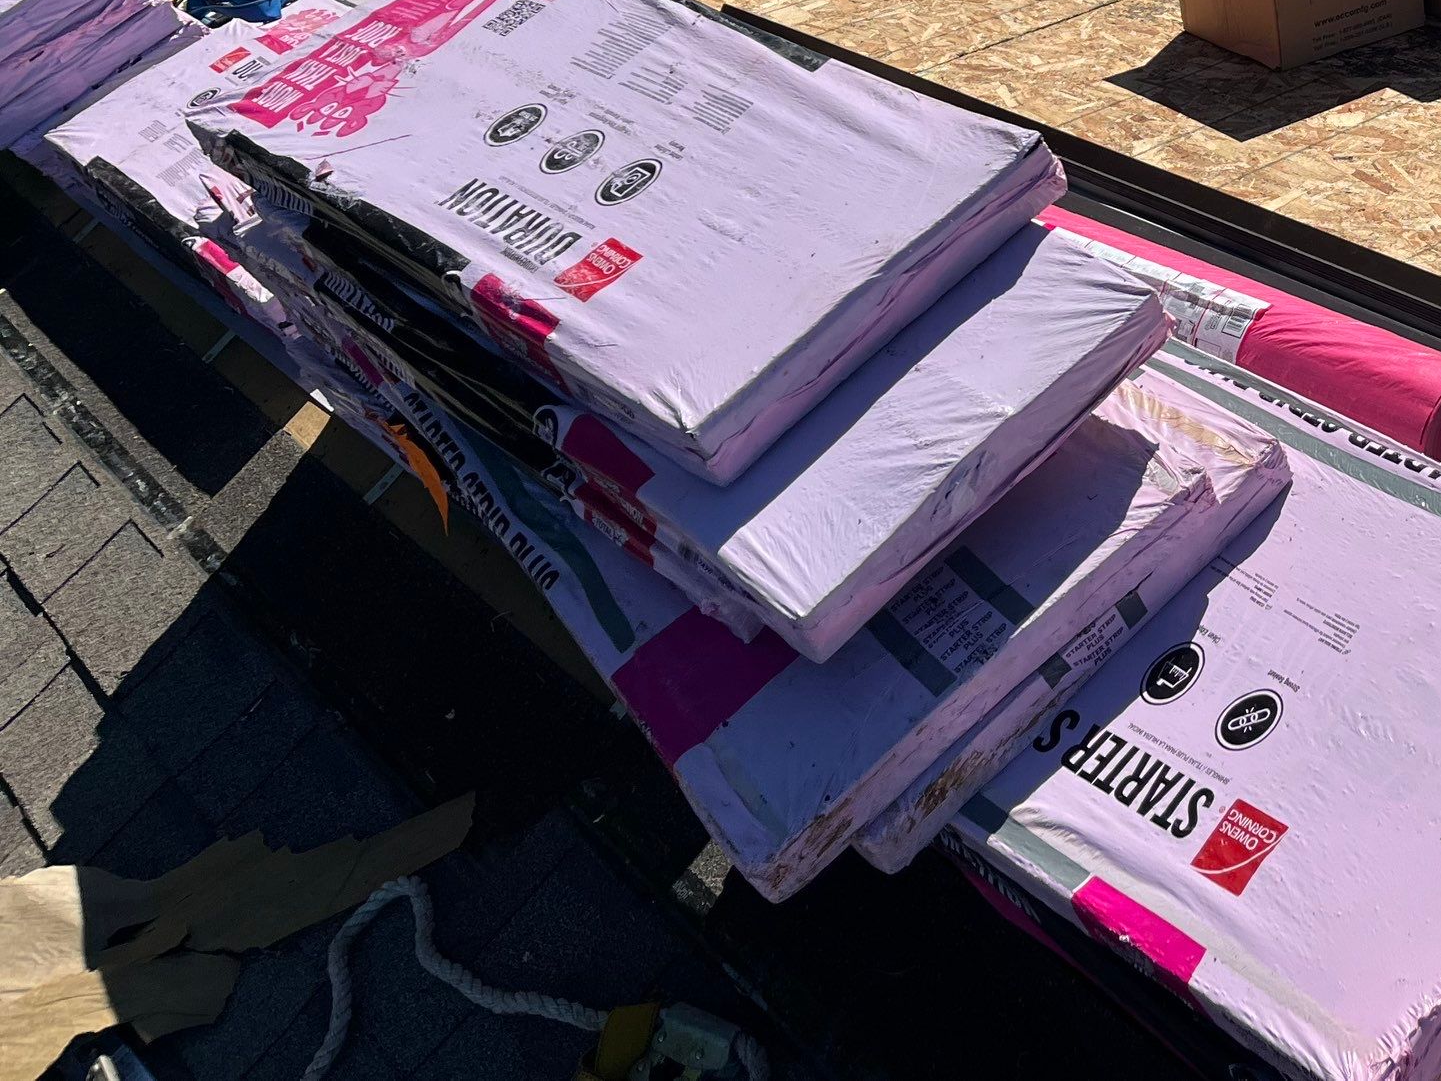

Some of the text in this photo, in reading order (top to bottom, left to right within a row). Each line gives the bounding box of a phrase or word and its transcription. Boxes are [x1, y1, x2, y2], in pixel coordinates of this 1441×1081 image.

[345, 20, 402, 48] ROOF
[319, 41, 368, 68] JUST A
[282, 58, 337, 91] THAN
[252, 81, 304, 113] MORE
[438, 178, 583, 266] DURATION
[588, 252, 616, 275] OWENS
[598, 243, 632, 269] CORNING
[940, 629, 973, 661] STARTER
[1065, 633, 1097, 658] STARTER
[1097, 614, 1116, 634] STRIP
[1073, 645, 1105, 667] STARTER
[1104, 626, 1124, 647] STRIP
[1086, 634, 1105, 651] PLUS
[1206, 631, 1221, 644] Clean
[1094, 647, 1112, 666] PLUS
[1282, 677, 1301, 693] Strong
[1175, 750, 1188, 762] PLUS
[1187, 756, 1203, 770] TEJAS
[1060, 722, 1215, 839] STARTER
[1206, 768, 1230, 785] SHINGLES
[1219, 820, 1259, 851] OWENS
[1226, 808, 1278, 844] CORNING
